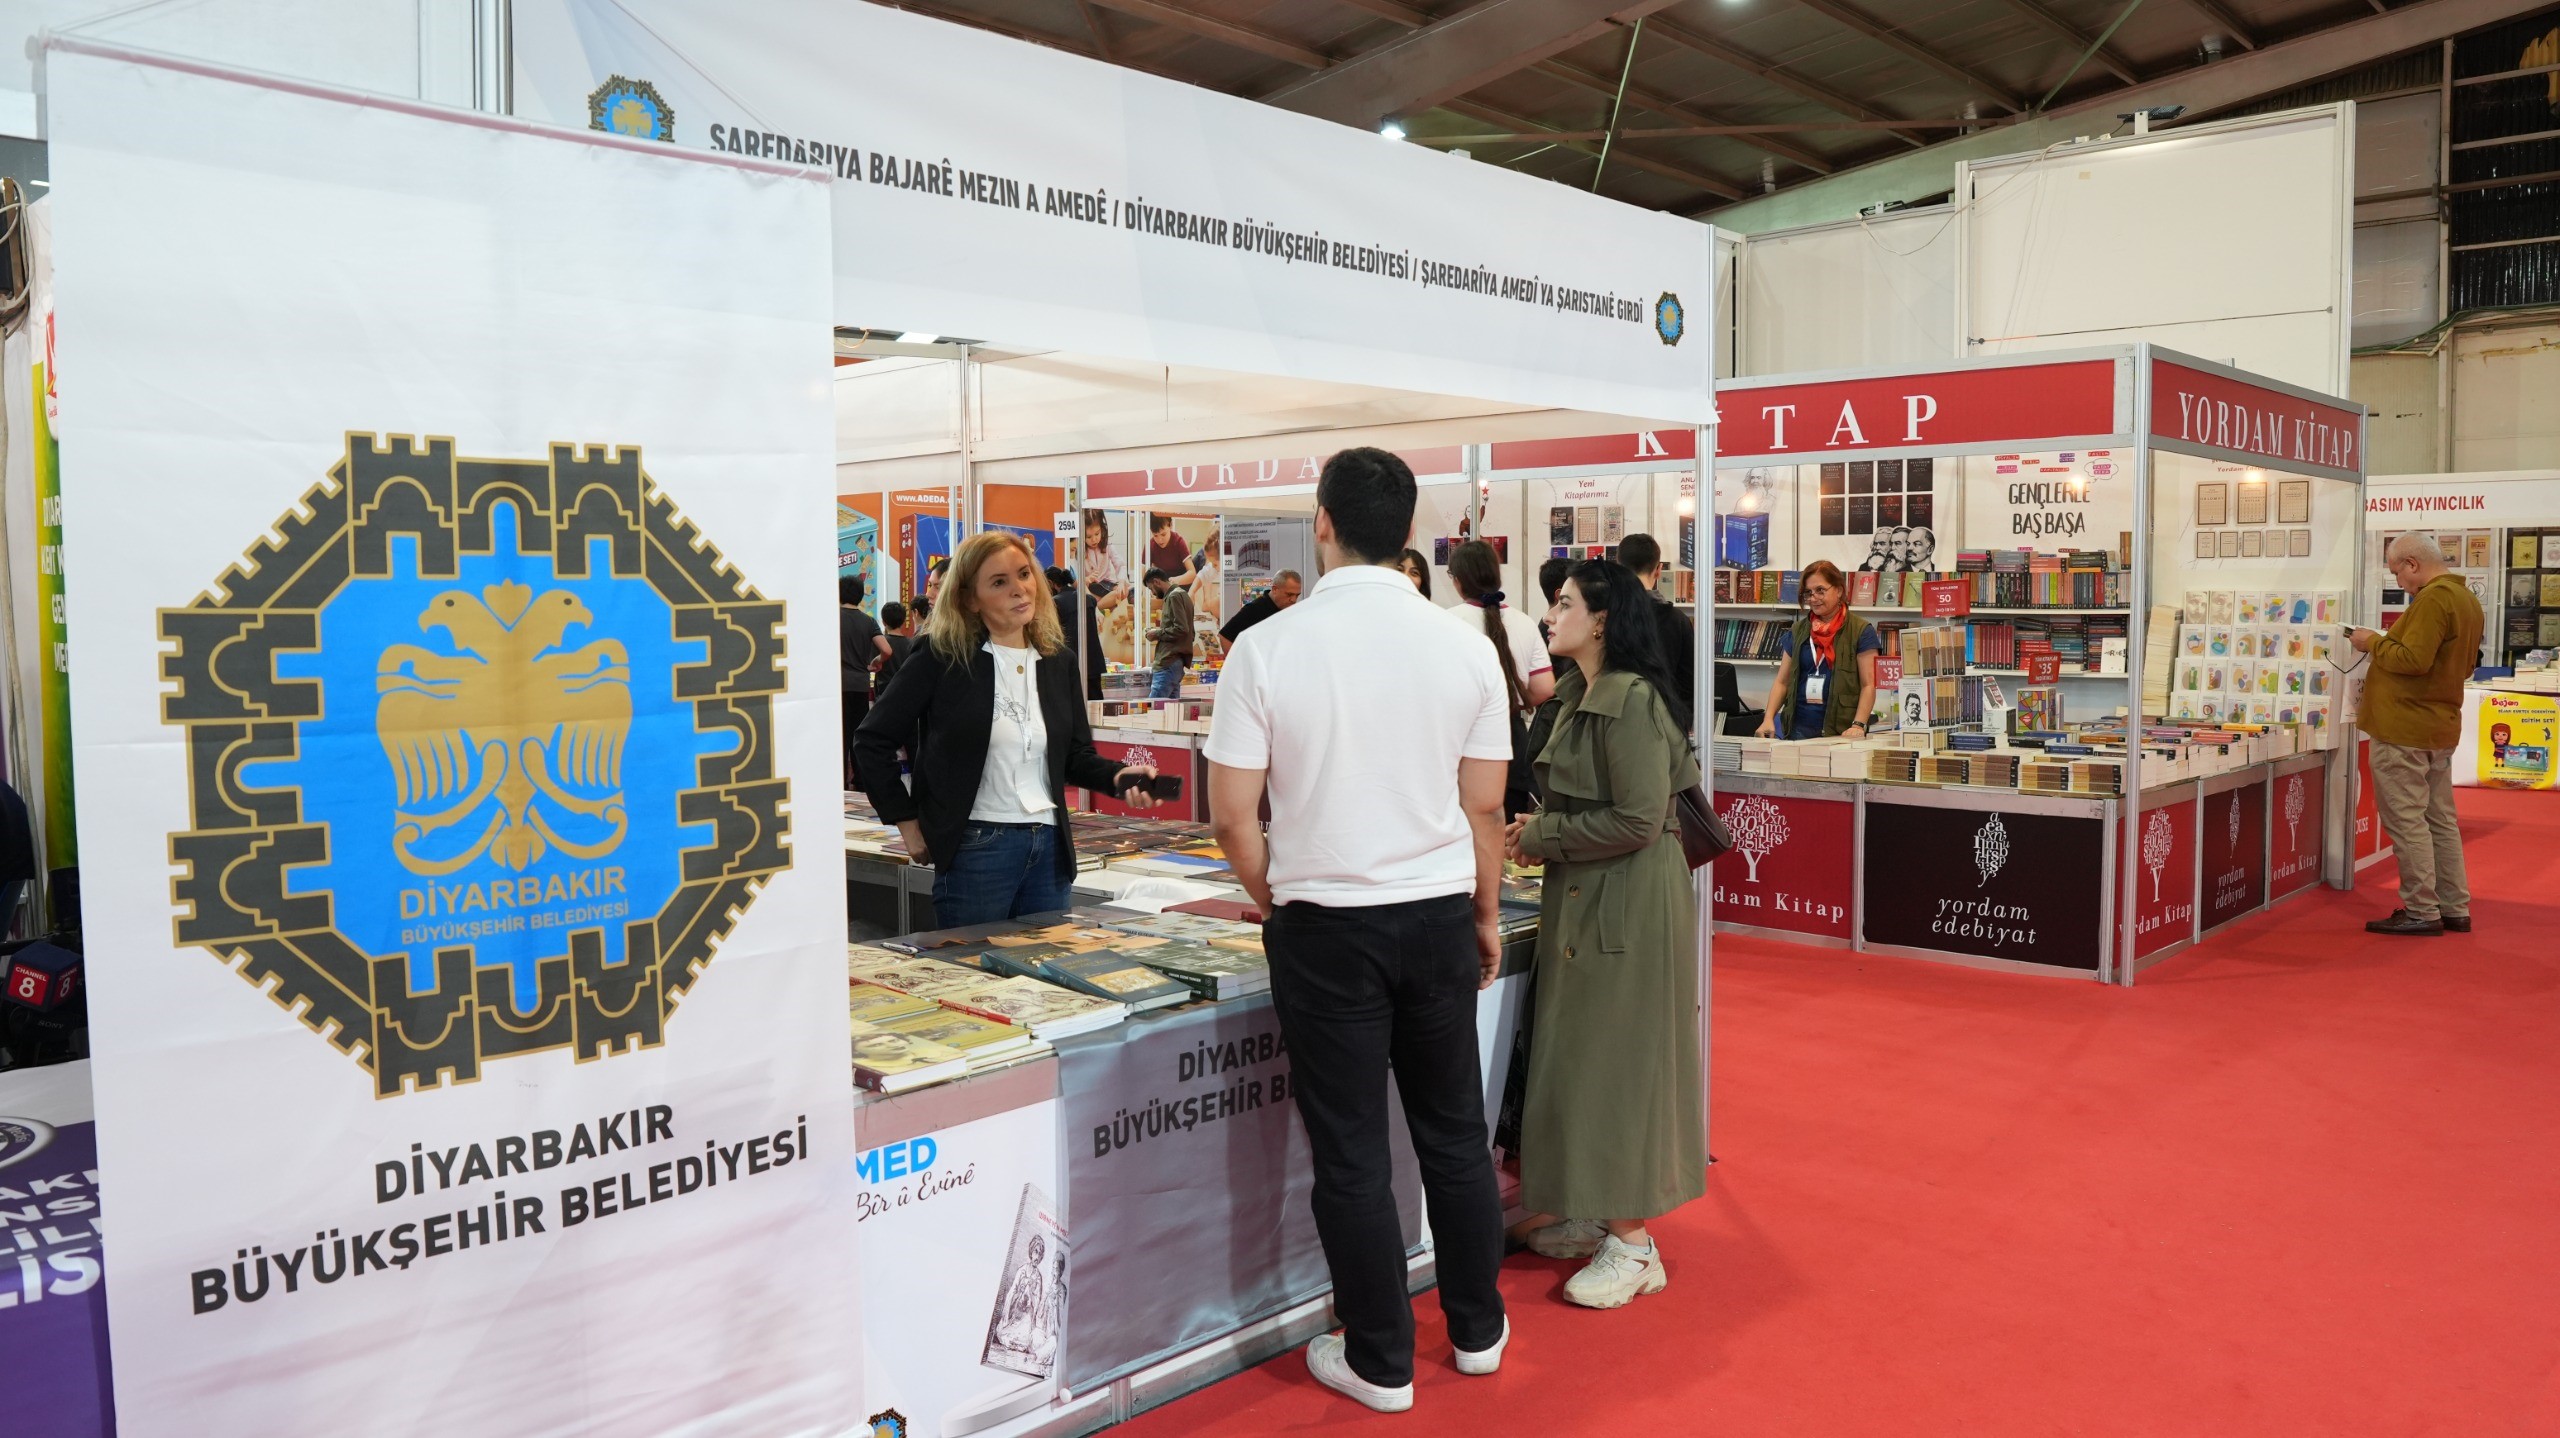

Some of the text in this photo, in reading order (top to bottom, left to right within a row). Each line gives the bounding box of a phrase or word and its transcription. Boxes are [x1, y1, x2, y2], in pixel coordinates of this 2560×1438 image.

[870, 152, 953, 197] BAJARÊ
[960, 169, 1020, 209] MEZIN
[1026, 183, 1040, 212] A
[1045, 187, 1107, 225] AMEDÊ
[1113, 200, 1120, 227] /
[1125, 196, 1228, 247] DİYARBAKIR
[1233, 217, 1328, 264] BÜYÜKŞEHİR
[1332, 242, 1409, 280] BELEDİYESİ
[1413, 257, 1418, 281] /
[1421, 260, 1498, 296] ŞAREDARÎYA
[1501, 275, 1539, 304] AMEDÎ
[1541, 284, 1554, 307] YA
[1557, 286, 1615, 318] ŞARISTANÊ
[1617, 297, 1644, 323] GIRDÎ
[2178, 391, 2354, 472] YORDAM KİTAP
[1564, 489, 1609, 501] Kitaplarımız
[1578, 479, 1596, 488] Yeni
[2008, 481, 2091, 509] GENÇLERLE
[2407, 495, 2486, 511] YAYINCILIK
[1058, 519, 1076, 531] 259A
[2012, 512, 2086, 538] BAŞ BAŞA
[2299, 855, 2317, 872] Kitap
[400, 866, 627, 920] DİYARBAKIR
[402, 898, 629, 945] BÜYÜKŞEHİR BELEDİYESİ
[1775, 893, 1844, 924] Kitap
[1936, 897, 2030, 921] yordam
[2165, 903, 2192, 924] Kitap
[1932, 916, 2037, 947] edebiyat
[15, 966, 47, 982] CHANNEL
[19, 977, 35, 998] 8
[60, 977, 71, 998] 8
[1093, 1076, 1262, 1159] BÜYÜKŞEHİR
[375, 1104, 674, 1204] DİYARBAKIR
[897, 1180, 911, 1206] û
[190, 1114, 809, 1316] BÜYÜKŞEHİR BELEDİYESİ
